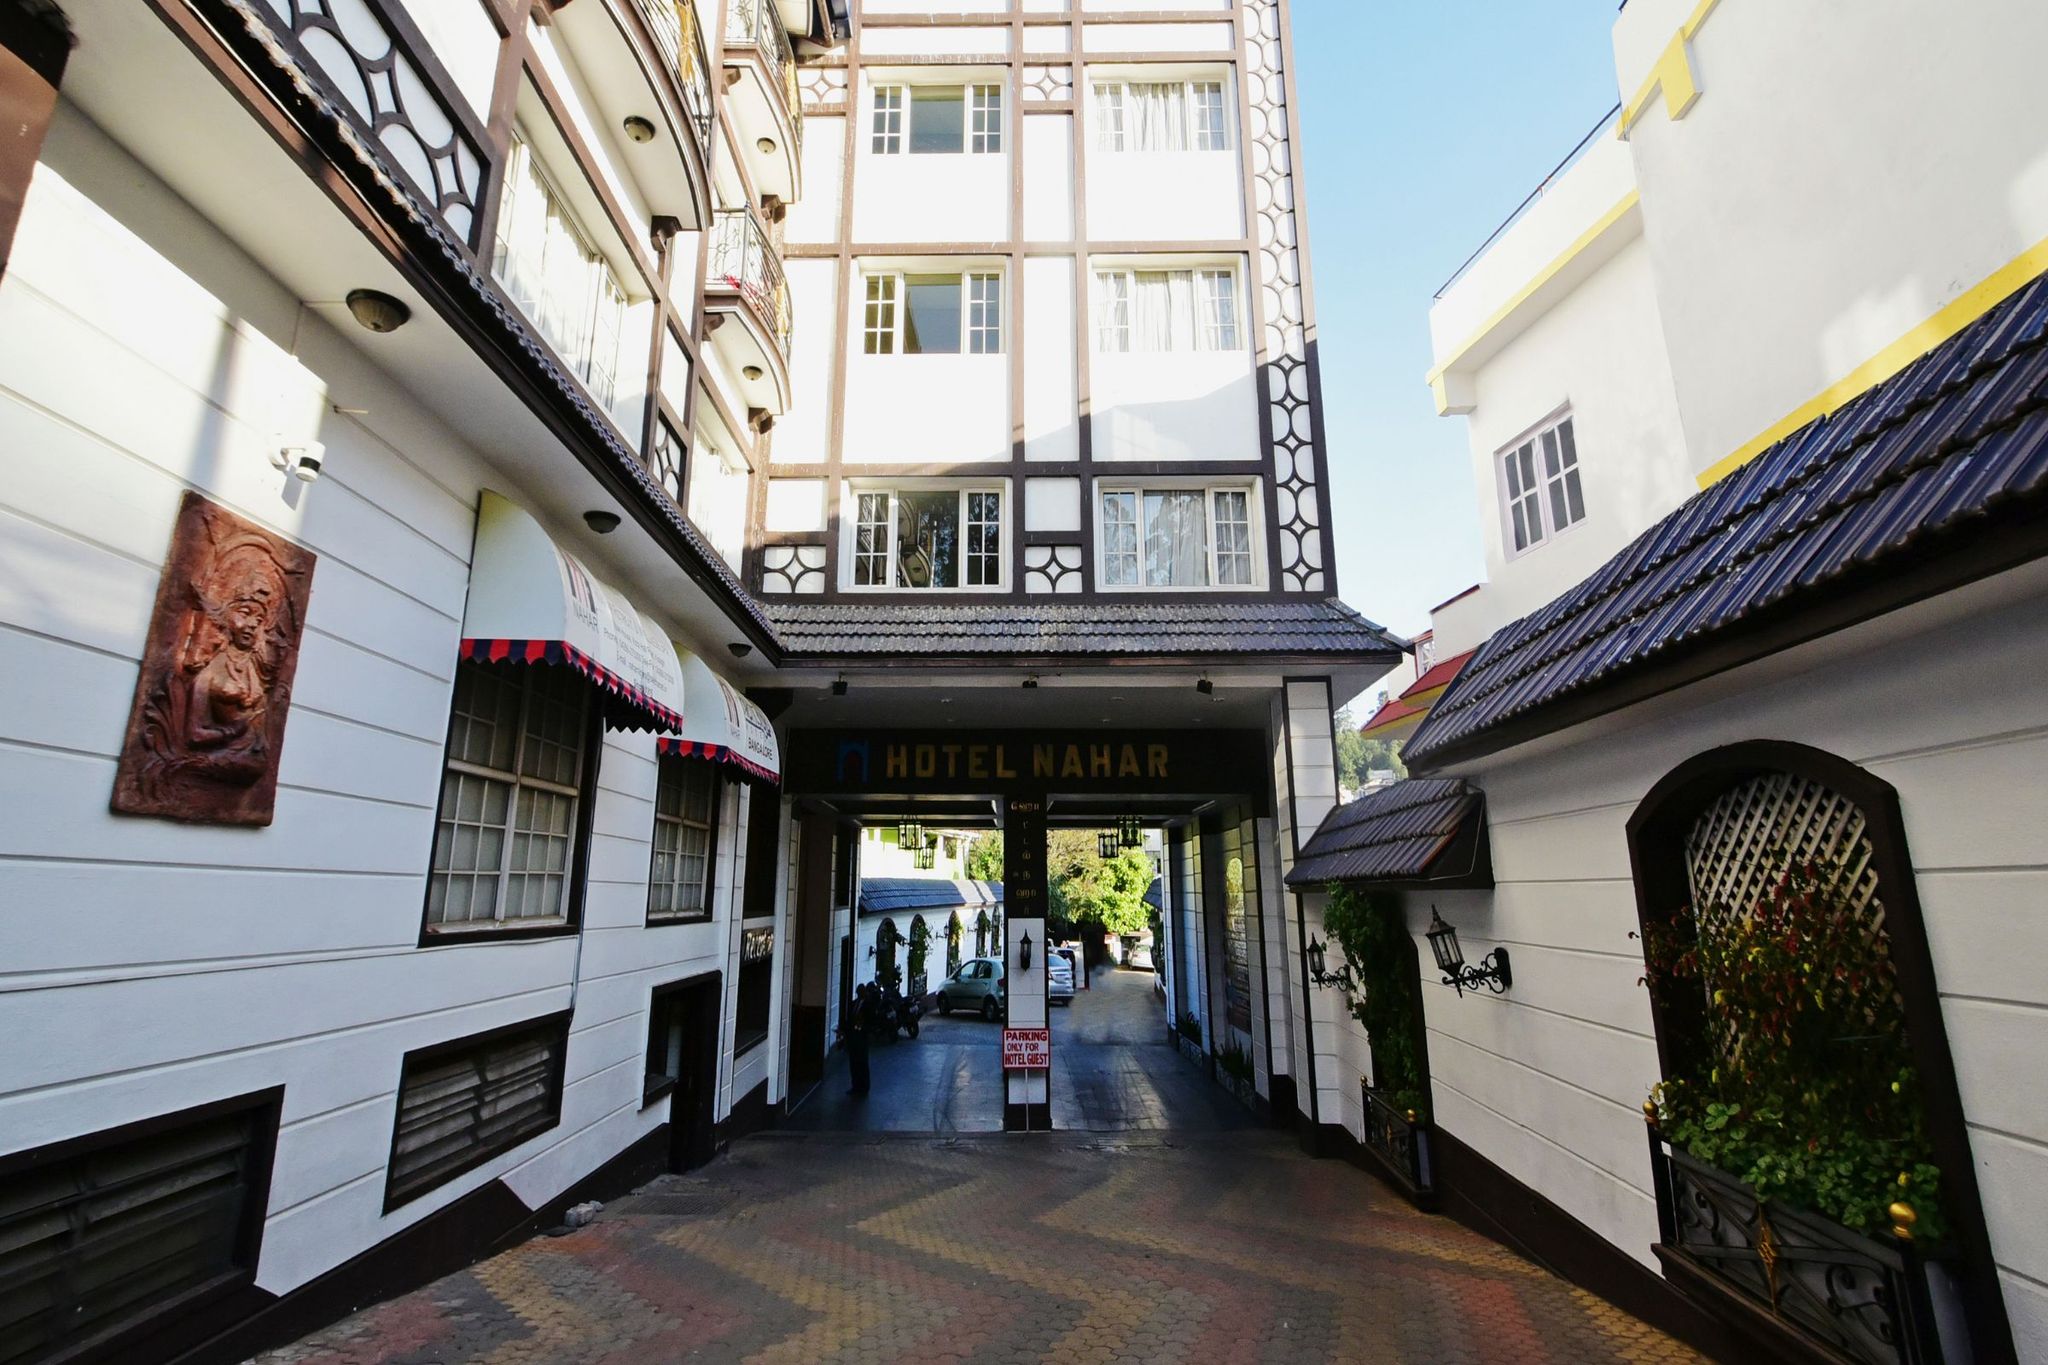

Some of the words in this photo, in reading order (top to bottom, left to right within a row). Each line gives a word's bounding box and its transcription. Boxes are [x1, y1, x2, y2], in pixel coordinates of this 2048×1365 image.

[885, 743, 1017, 778] HOTEL
[1033, 743, 1169, 778] NAHAR
[1006, 1031, 1047, 1041] PARKING
[1007, 1042, 1023, 1051] ONLY
[1025, 1042, 1039, 1051] FOR
[1005, 1053, 1026, 1065] HOTEL
[1027, 1053, 1047, 1065] GUEST
